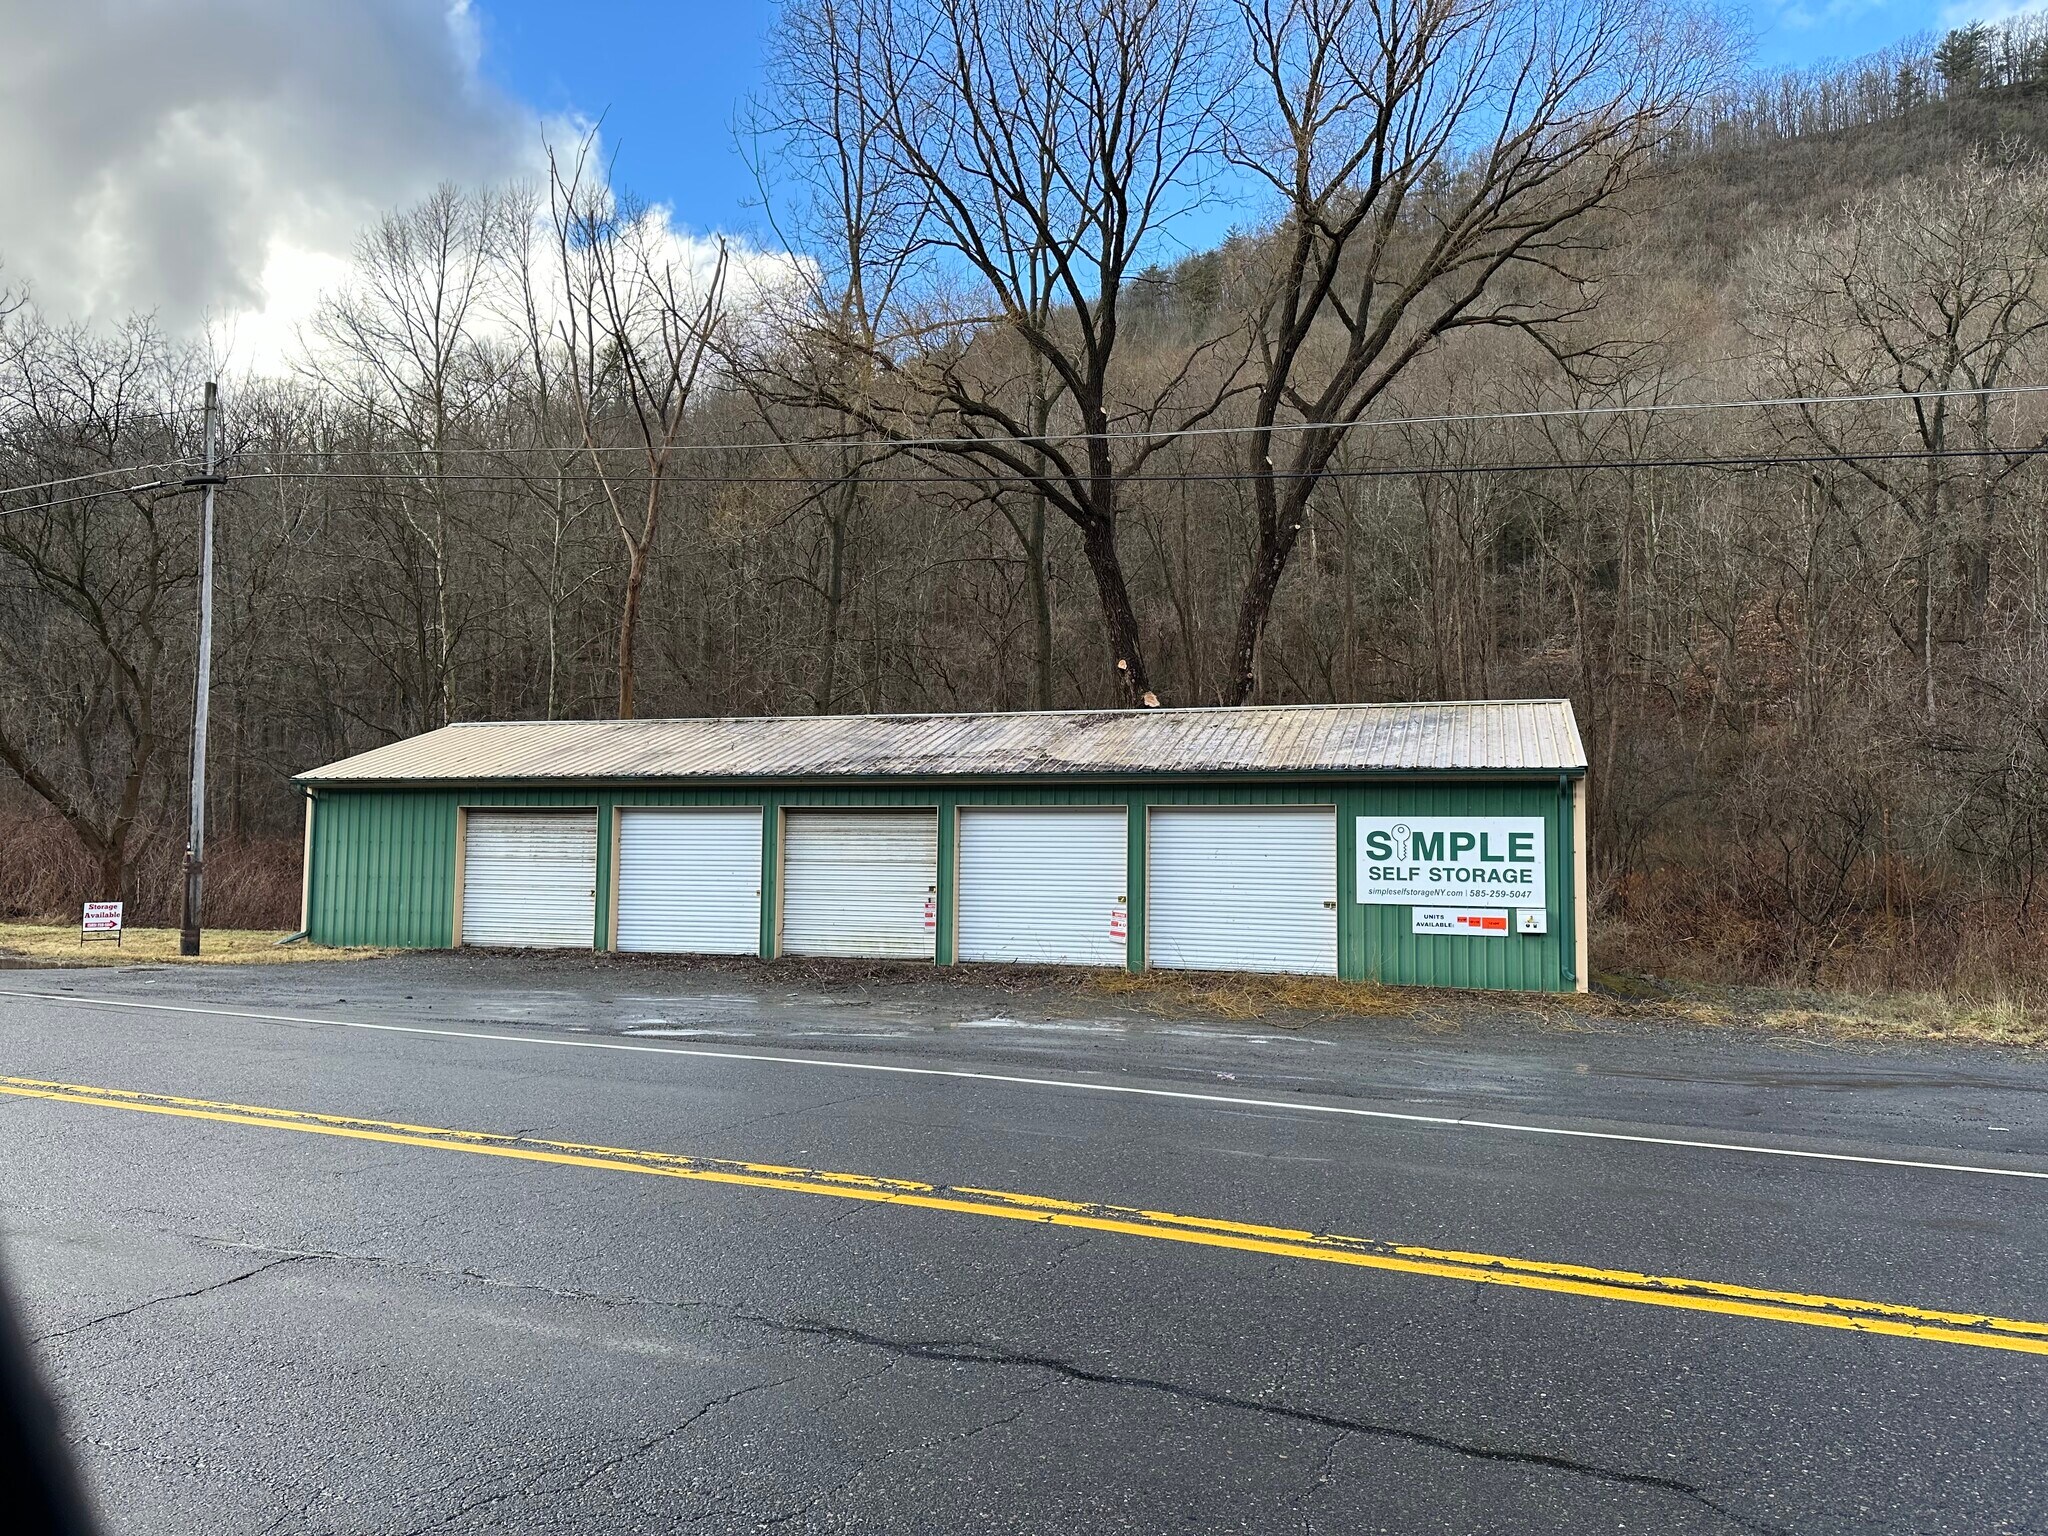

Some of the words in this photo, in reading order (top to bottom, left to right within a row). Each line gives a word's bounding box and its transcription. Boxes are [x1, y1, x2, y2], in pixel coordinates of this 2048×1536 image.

[1368, 866, 1420, 881] SELF
[1429, 867, 1533, 884] STORAGE
[1368, 887, 1463, 897] simpleselfstorageNY.com
[1469, 889, 1532, 899] 585-259-5047
